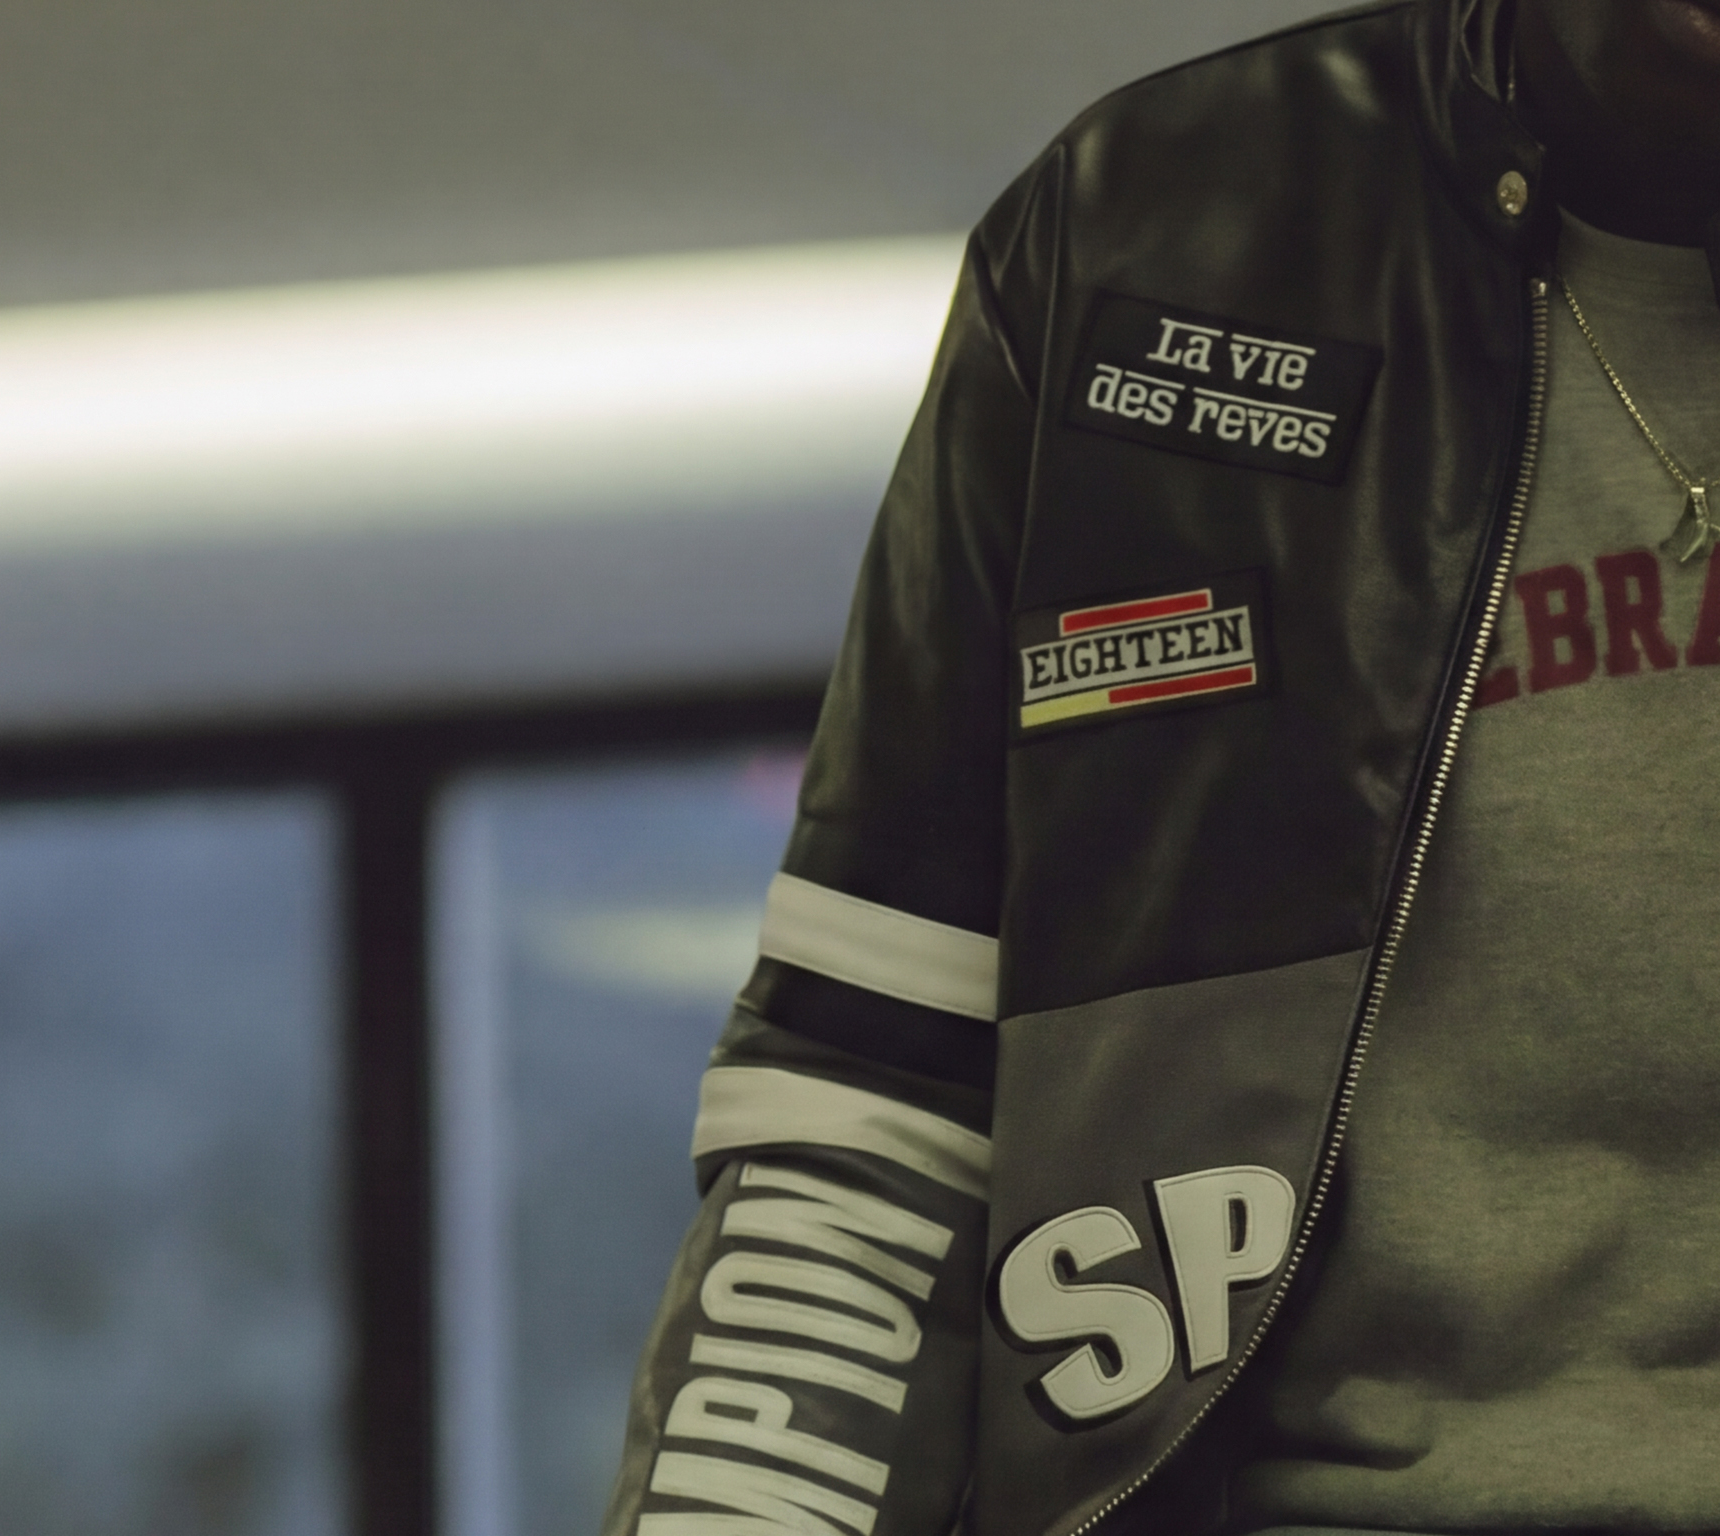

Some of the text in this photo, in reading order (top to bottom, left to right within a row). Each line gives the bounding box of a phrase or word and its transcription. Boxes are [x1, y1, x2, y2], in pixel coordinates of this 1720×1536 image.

[1087, 364, 1185, 425] des
[1026, 613, 1244, 690] EIGHTEEN
[996, 1164, 1297, 1421] SP
